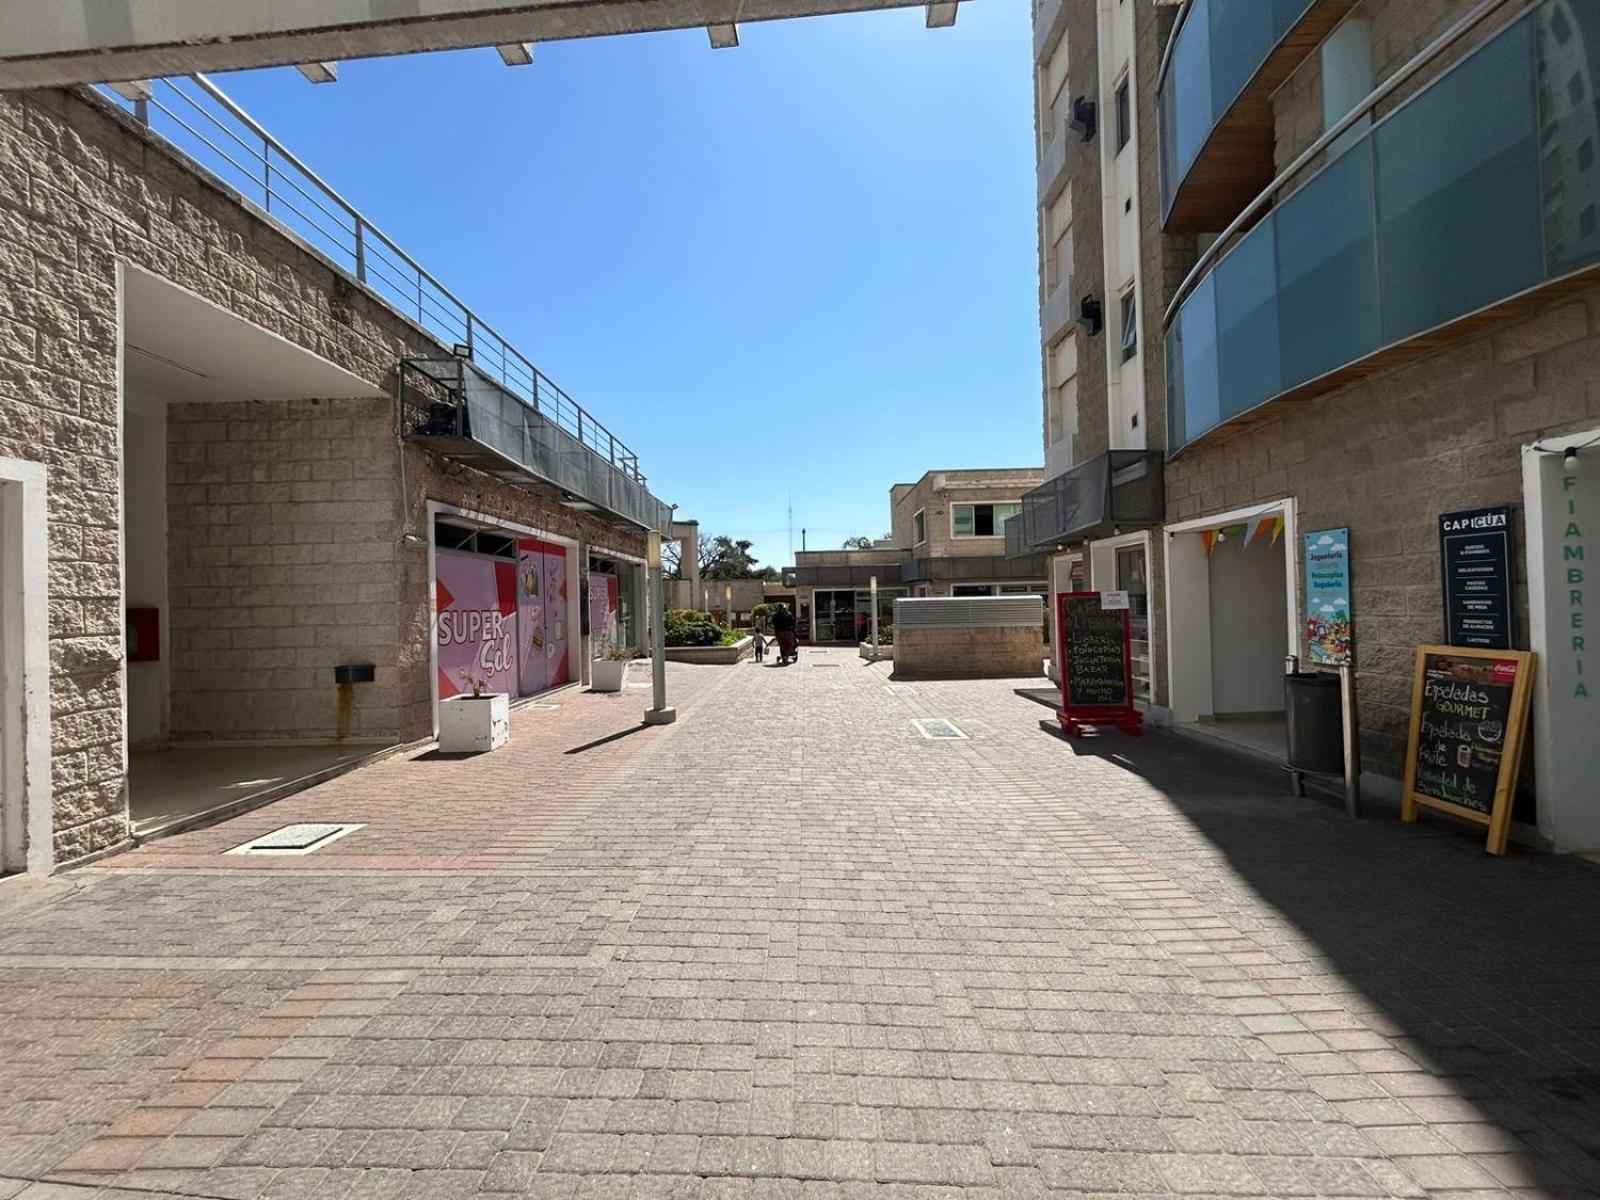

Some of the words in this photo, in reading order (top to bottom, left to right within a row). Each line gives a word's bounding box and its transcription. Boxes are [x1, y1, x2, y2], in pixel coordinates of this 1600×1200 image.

[1443, 513, 1506, 531] CAPICÚA
[1563, 476, 1588, 698] FIAMBRERIA
[437, 609, 505, 646] SUPER
[480, 632, 513, 678] Sol
[1424, 679, 1490, 704] Ensaladas
[1436, 701, 1491, 720] GOURMET
[1462, 776, 1476, 793] de
